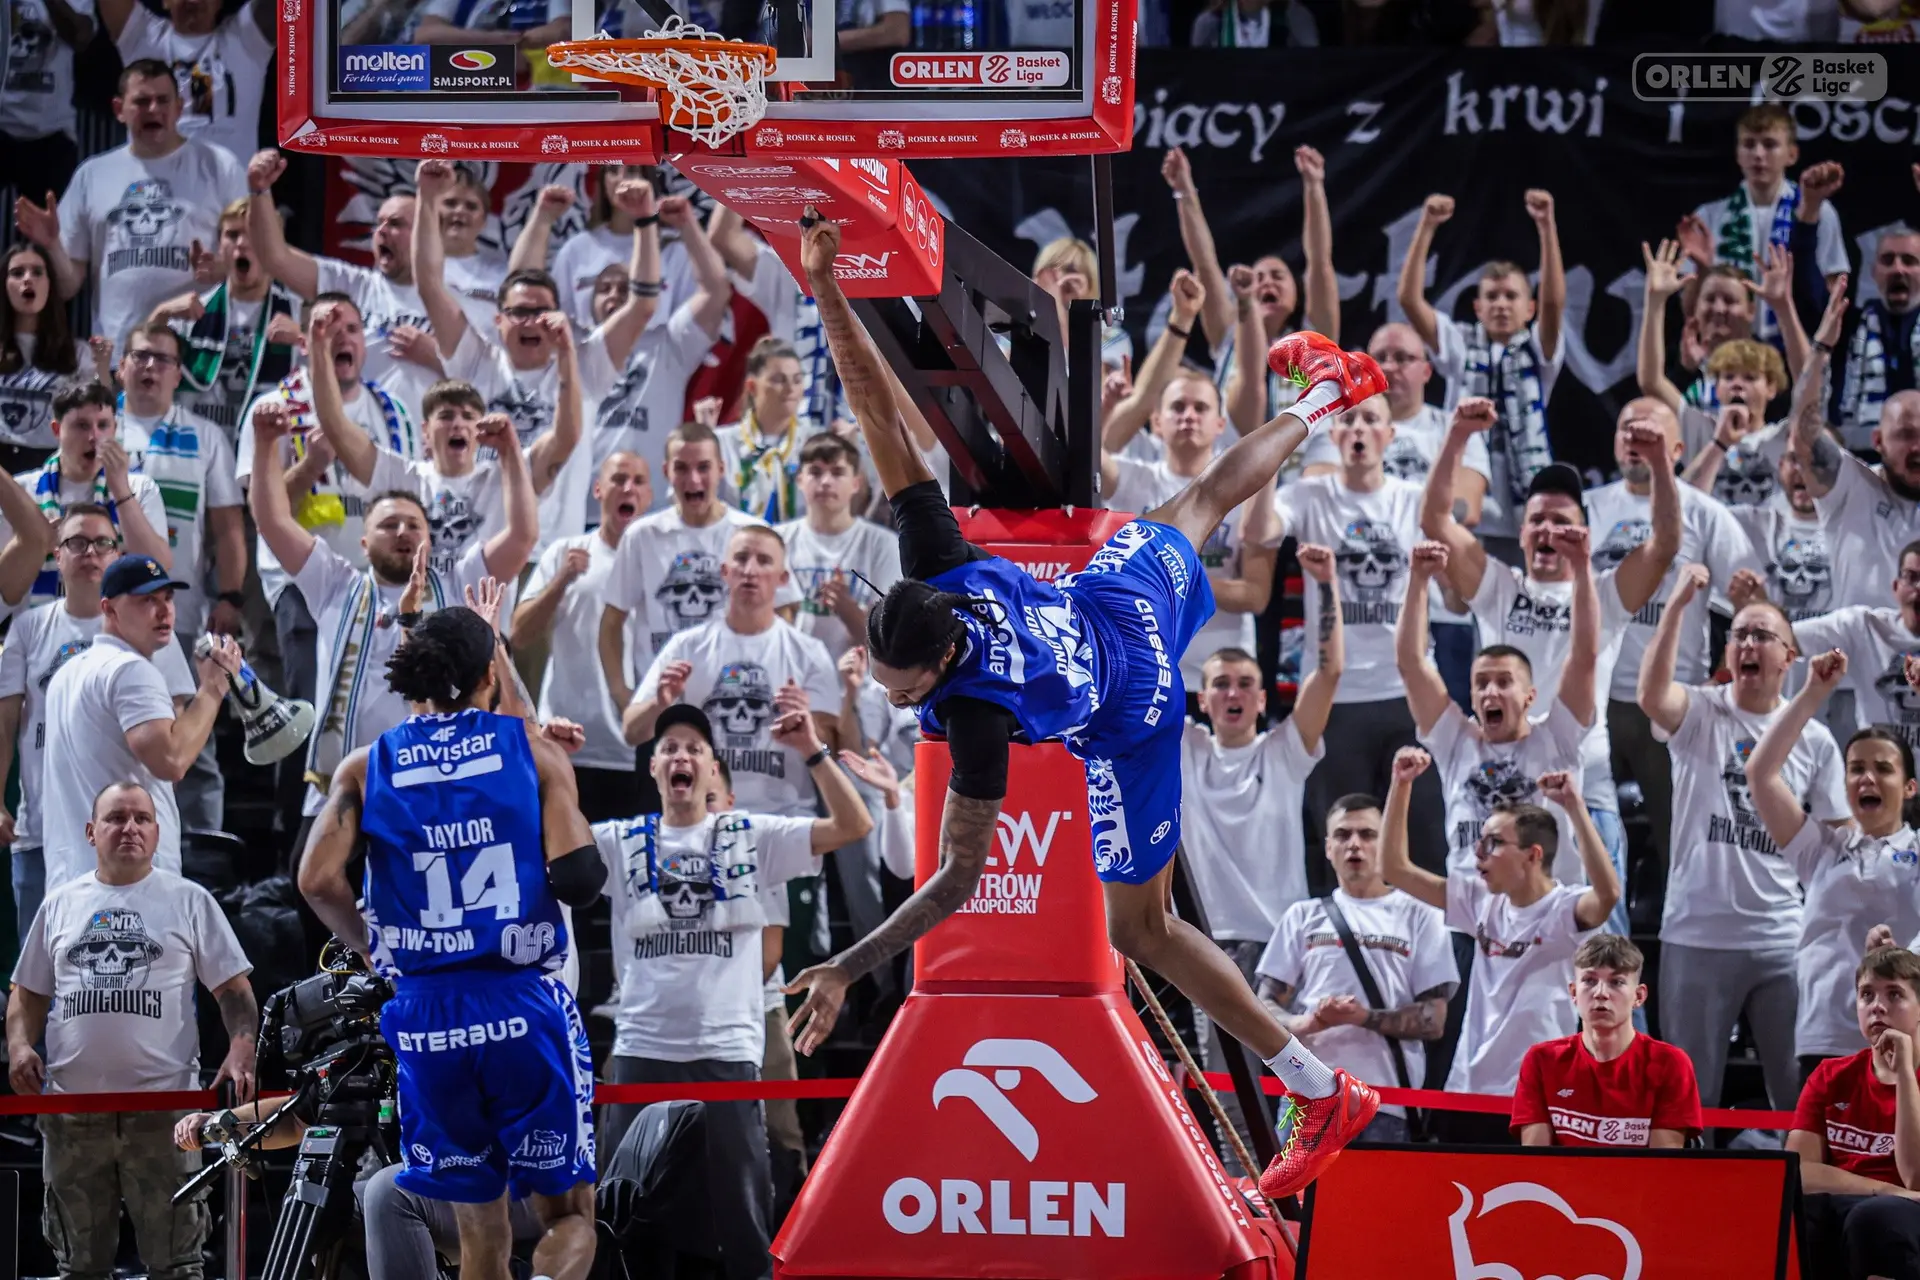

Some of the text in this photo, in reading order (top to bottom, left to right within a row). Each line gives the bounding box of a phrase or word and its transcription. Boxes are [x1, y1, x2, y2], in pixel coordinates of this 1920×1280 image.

[1109, 1, 1119, 73] ROSIEK & ROSIEK
[346, 52, 425, 71] molten
[899, 60, 974, 79] ORLEN
[1016, 56, 1060, 68] Basket
[344, 74, 425, 86] For the real game
[433, 76, 512, 88] SMJSPORT.PL
[1016, 70, 1044, 83] Liga
[1345, 102, 1385, 144] z
[1444, 69, 1607, 138] krwi
[329, 135, 358, 143] ROSIEK
[368, 136, 399, 145] ROSIEK
[451, 141, 478, 149] ROSIEK
[488, 141, 519, 149] ROSIEK
[571, 138, 640, 147] ROSIEK & ROSIEK
[786, 134, 815, 143] ROSIEK
[908, 135, 937, 143] ROSIEK
[939, 135, 945, 143] &
[1029, 132, 1100, 142] ROSIEK & ROSIEK
[1135, 599, 1172, 704] TERBUD
[430, 726, 457, 742] 4F
[397, 732, 497, 767] anvistar
[422, 817, 495, 849] TAYLOR
[412, 842, 521, 929] 14
[975, 867, 1043, 899] TRÓW
[411, 1016, 528, 1053] TERBUD
[1552, 1114, 1594, 1135] RLEN
[1624, 1122, 1650, 1131] Bask
[1623, 1132, 1644, 1142] Liga
[1827, 1129, 1869, 1149] RLEN
[882, 1177, 1126, 1238] ORLEN
